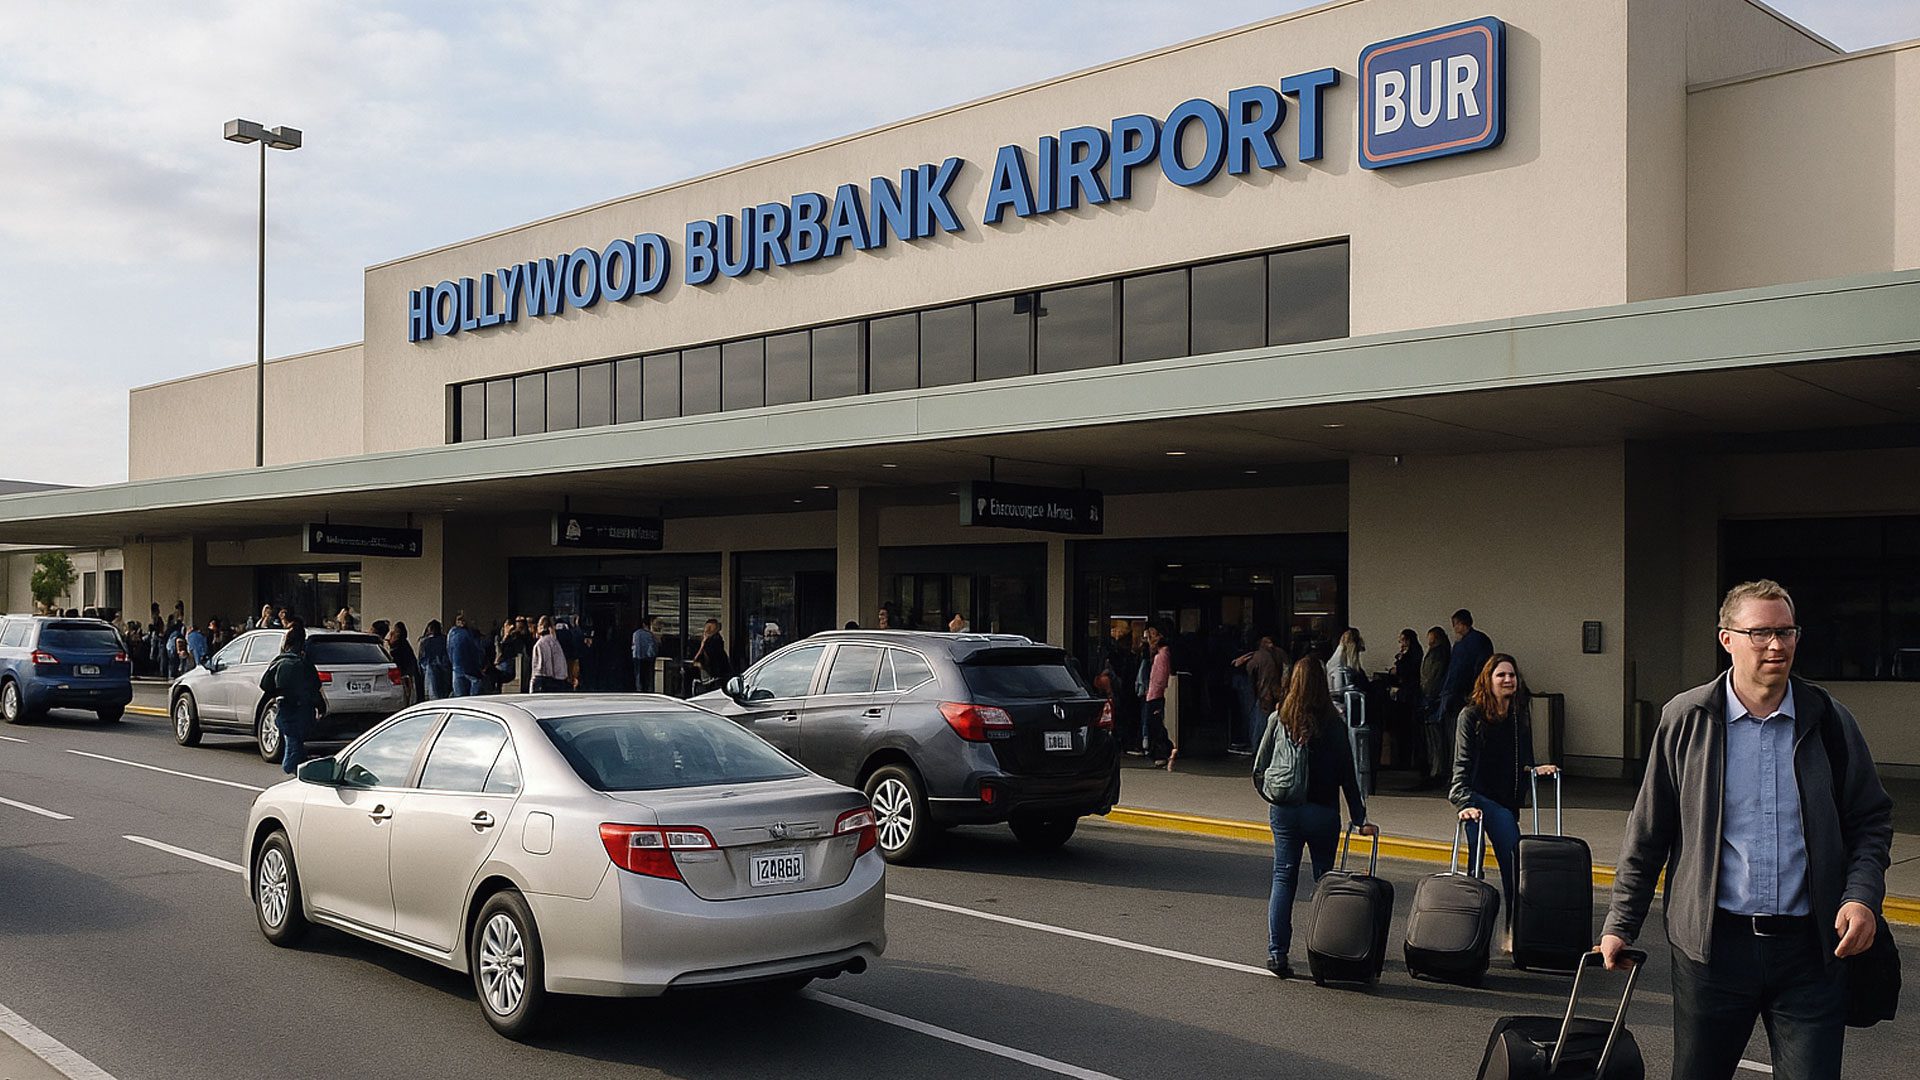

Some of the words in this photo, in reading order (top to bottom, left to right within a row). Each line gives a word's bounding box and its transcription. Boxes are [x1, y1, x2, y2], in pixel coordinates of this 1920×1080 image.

[1374, 54, 1480, 136] BUR
[408, 232, 671, 343] HOLLYWOOD
[685, 156, 965, 286] BURBANK
[983, 67, 1340, 225] AIRPORT
